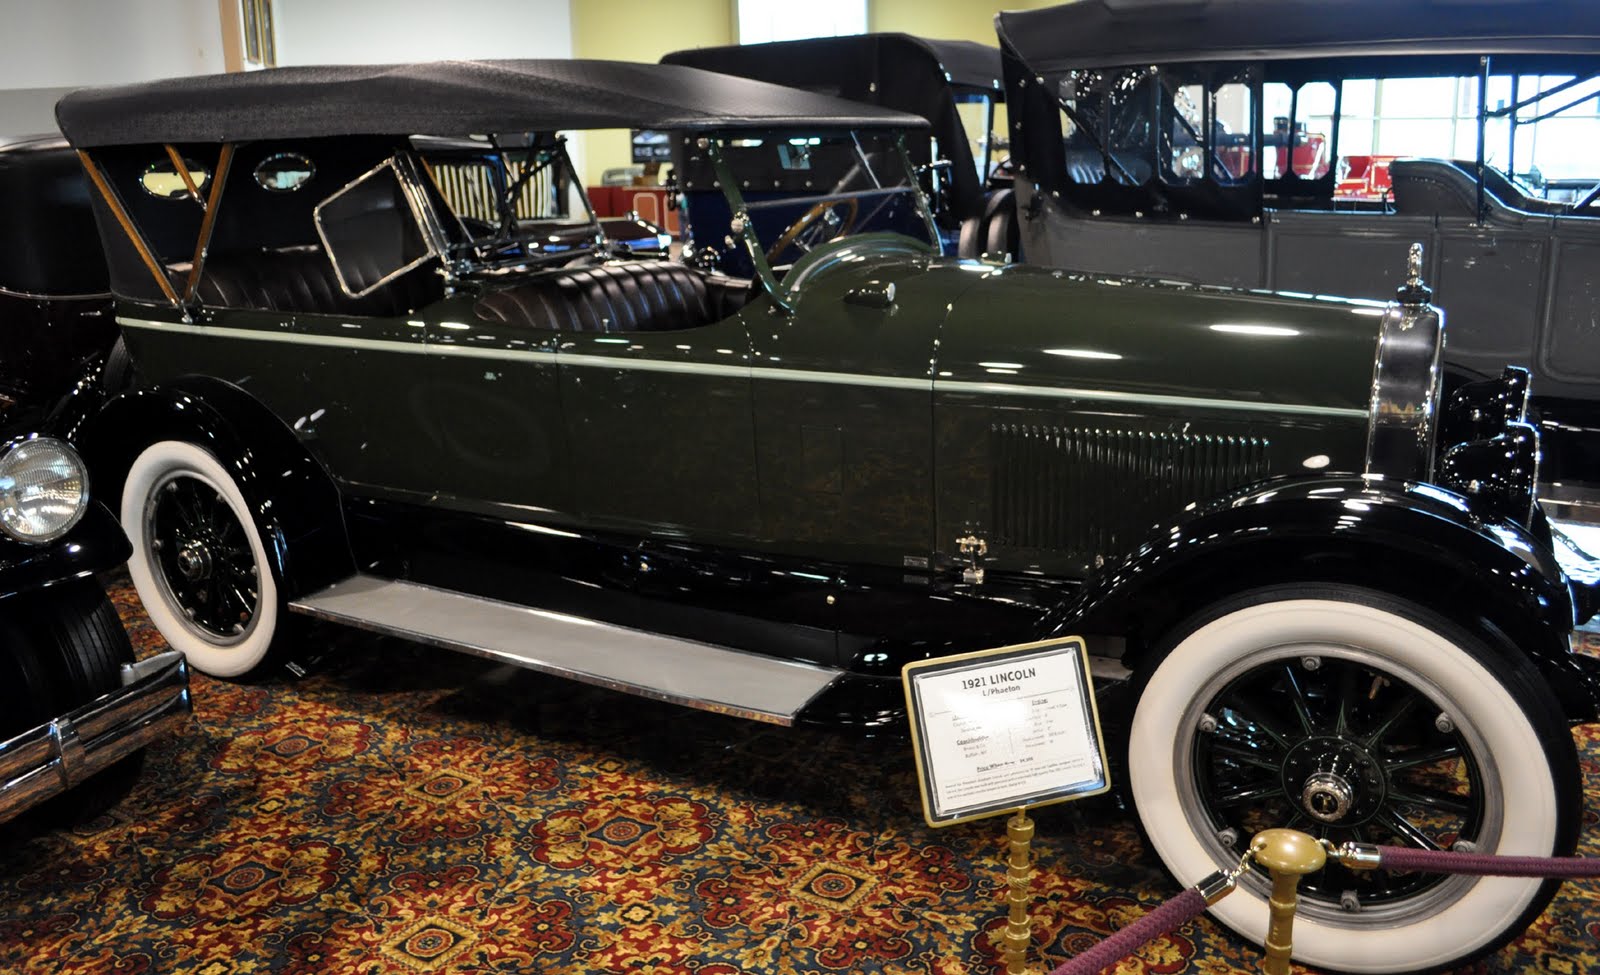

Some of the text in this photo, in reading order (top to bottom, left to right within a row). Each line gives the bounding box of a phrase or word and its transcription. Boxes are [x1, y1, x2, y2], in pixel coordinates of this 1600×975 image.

[962, 668, 1037, 690] 1921 LINCOLN
[982, 685, 1021, 697] L/Phaeton
